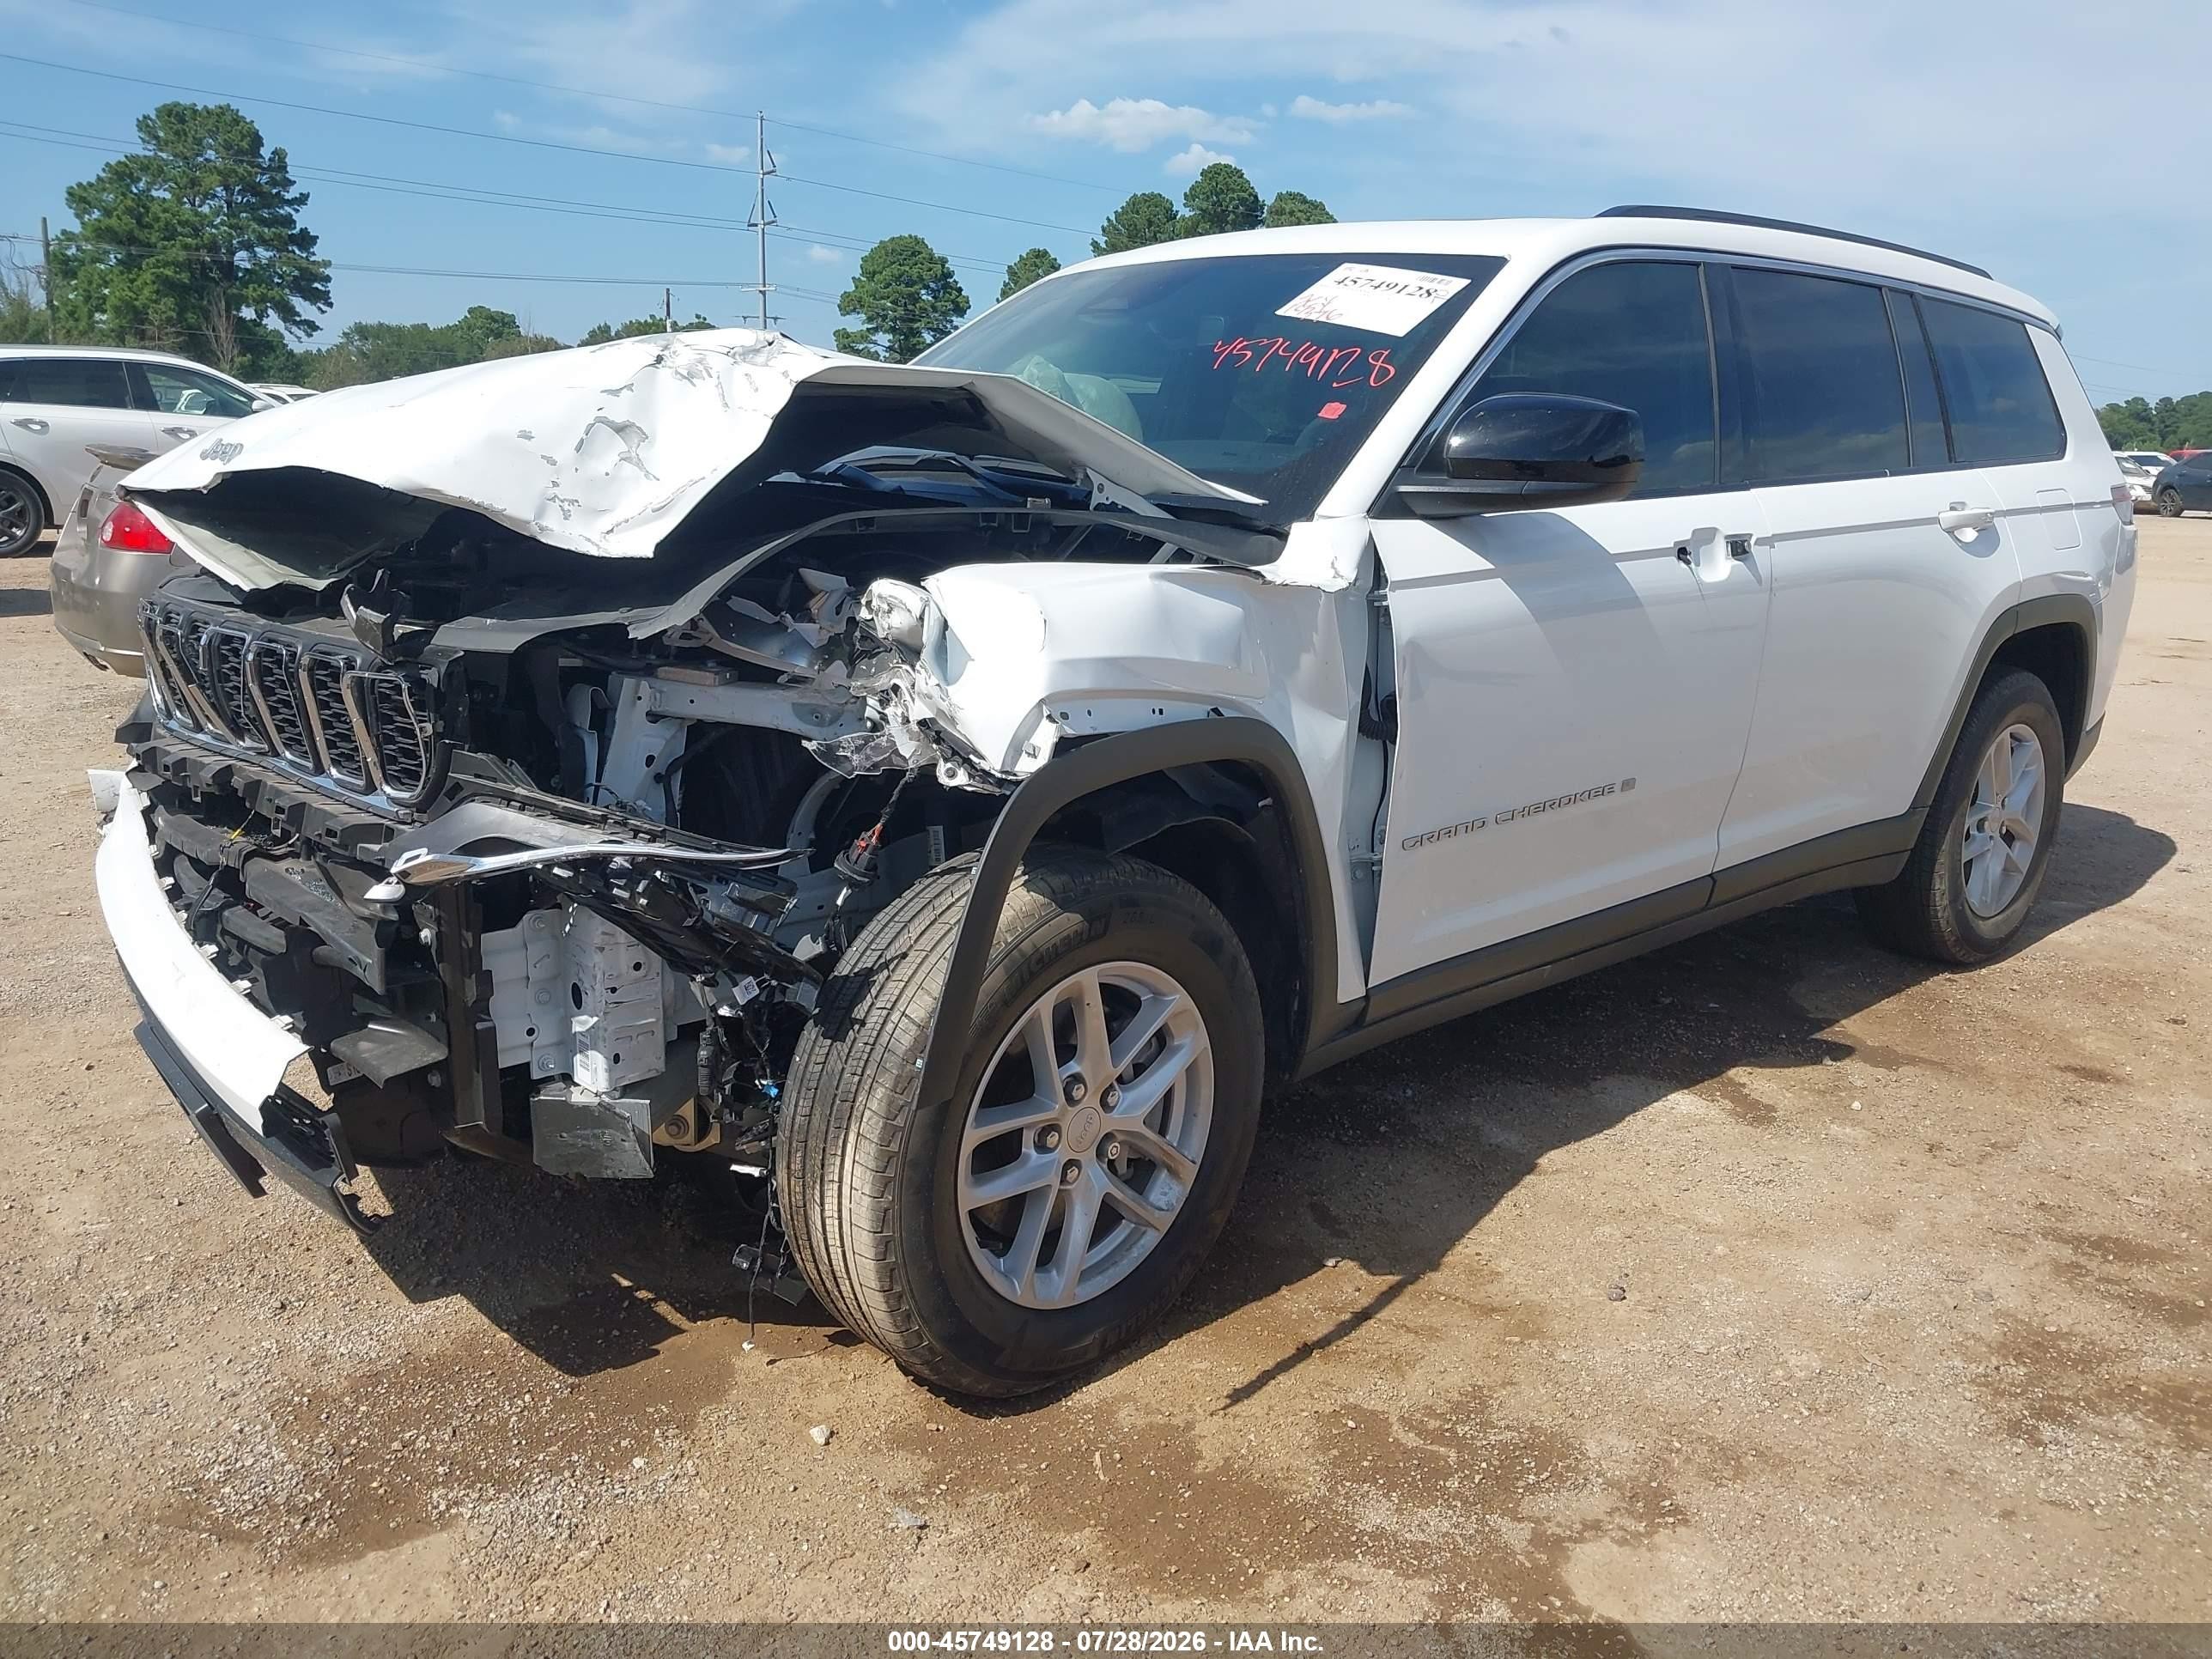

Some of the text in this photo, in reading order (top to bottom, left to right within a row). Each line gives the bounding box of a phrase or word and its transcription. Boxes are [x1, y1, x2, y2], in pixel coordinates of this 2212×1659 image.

[1334, 276, 1437, 298] 45749128
[1213, 337, 1395, 387] 45749128
[200, 438, 244, 465] Jeep
[1401, 782, 1617, 851] GRAND CHEROKEE
